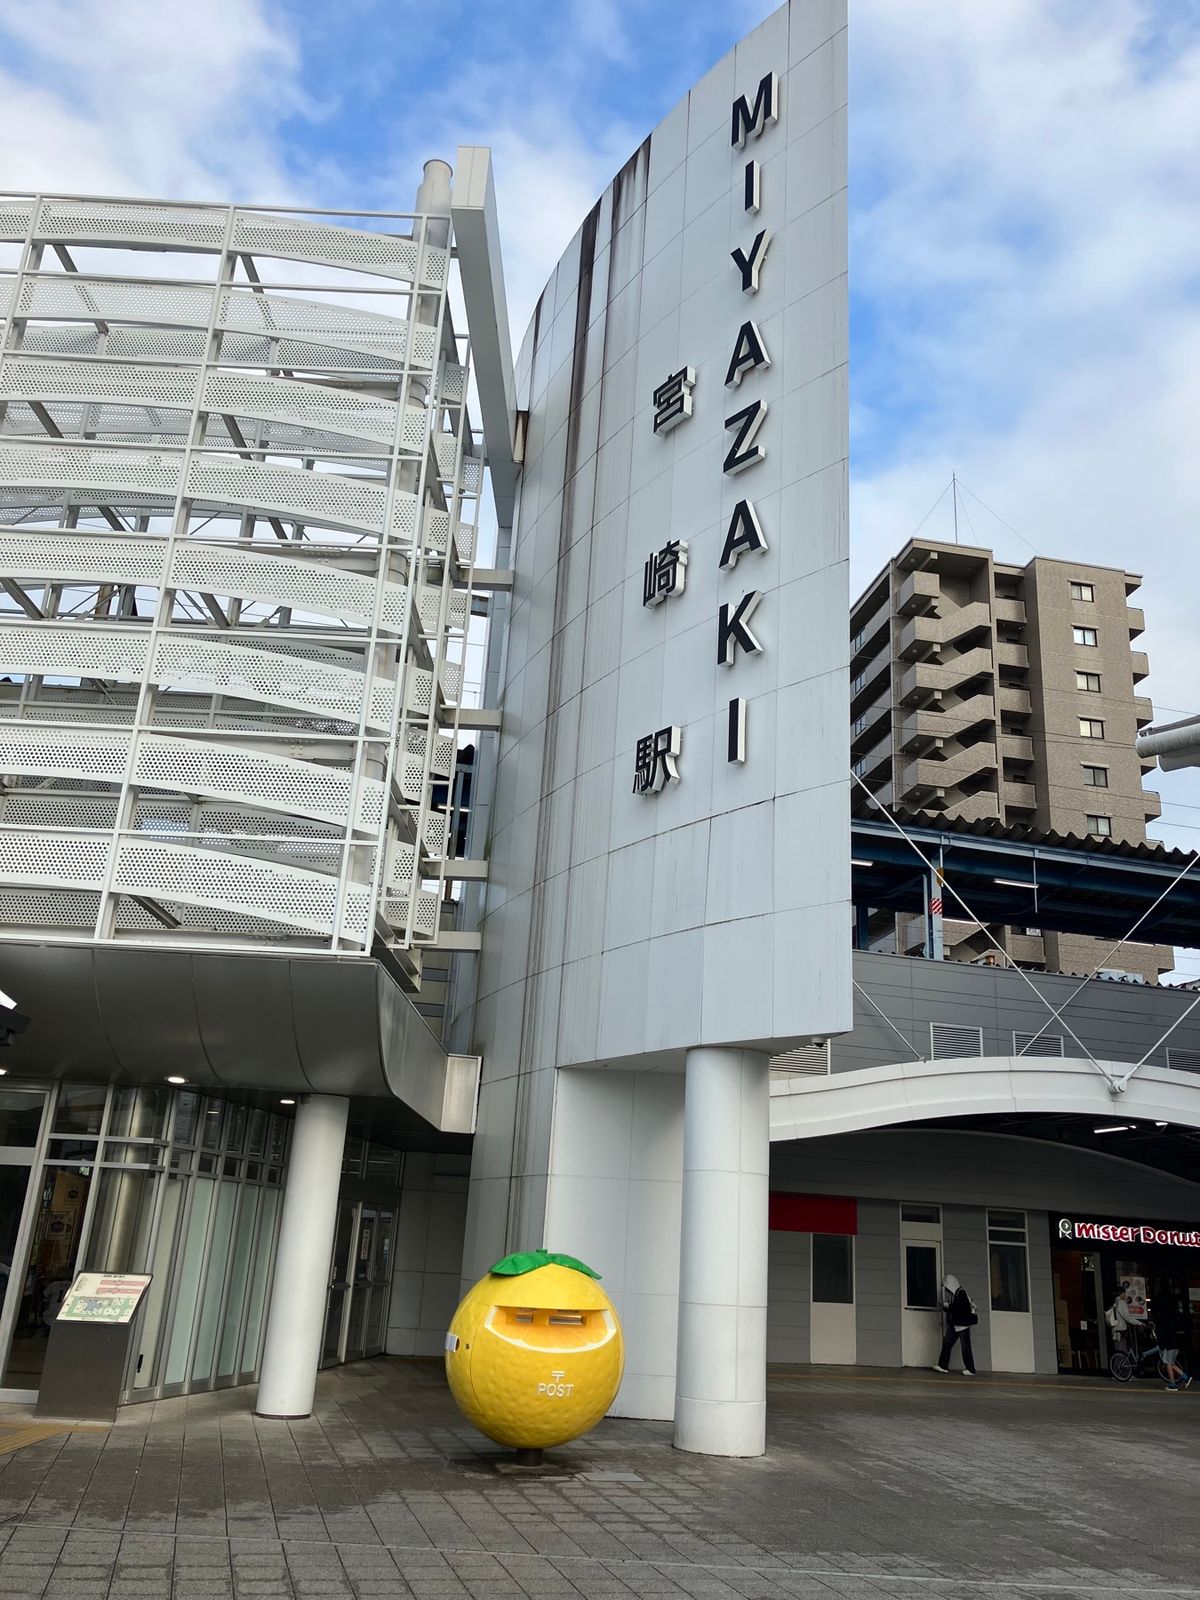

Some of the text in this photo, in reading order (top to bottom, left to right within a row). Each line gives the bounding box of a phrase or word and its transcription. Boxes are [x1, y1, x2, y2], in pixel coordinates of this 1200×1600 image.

[633, 366, 694, 796] 宮崎駅
[717, 71, 777, 765] MIYAZAKI
[537, 1383, 574, 1397] POST
